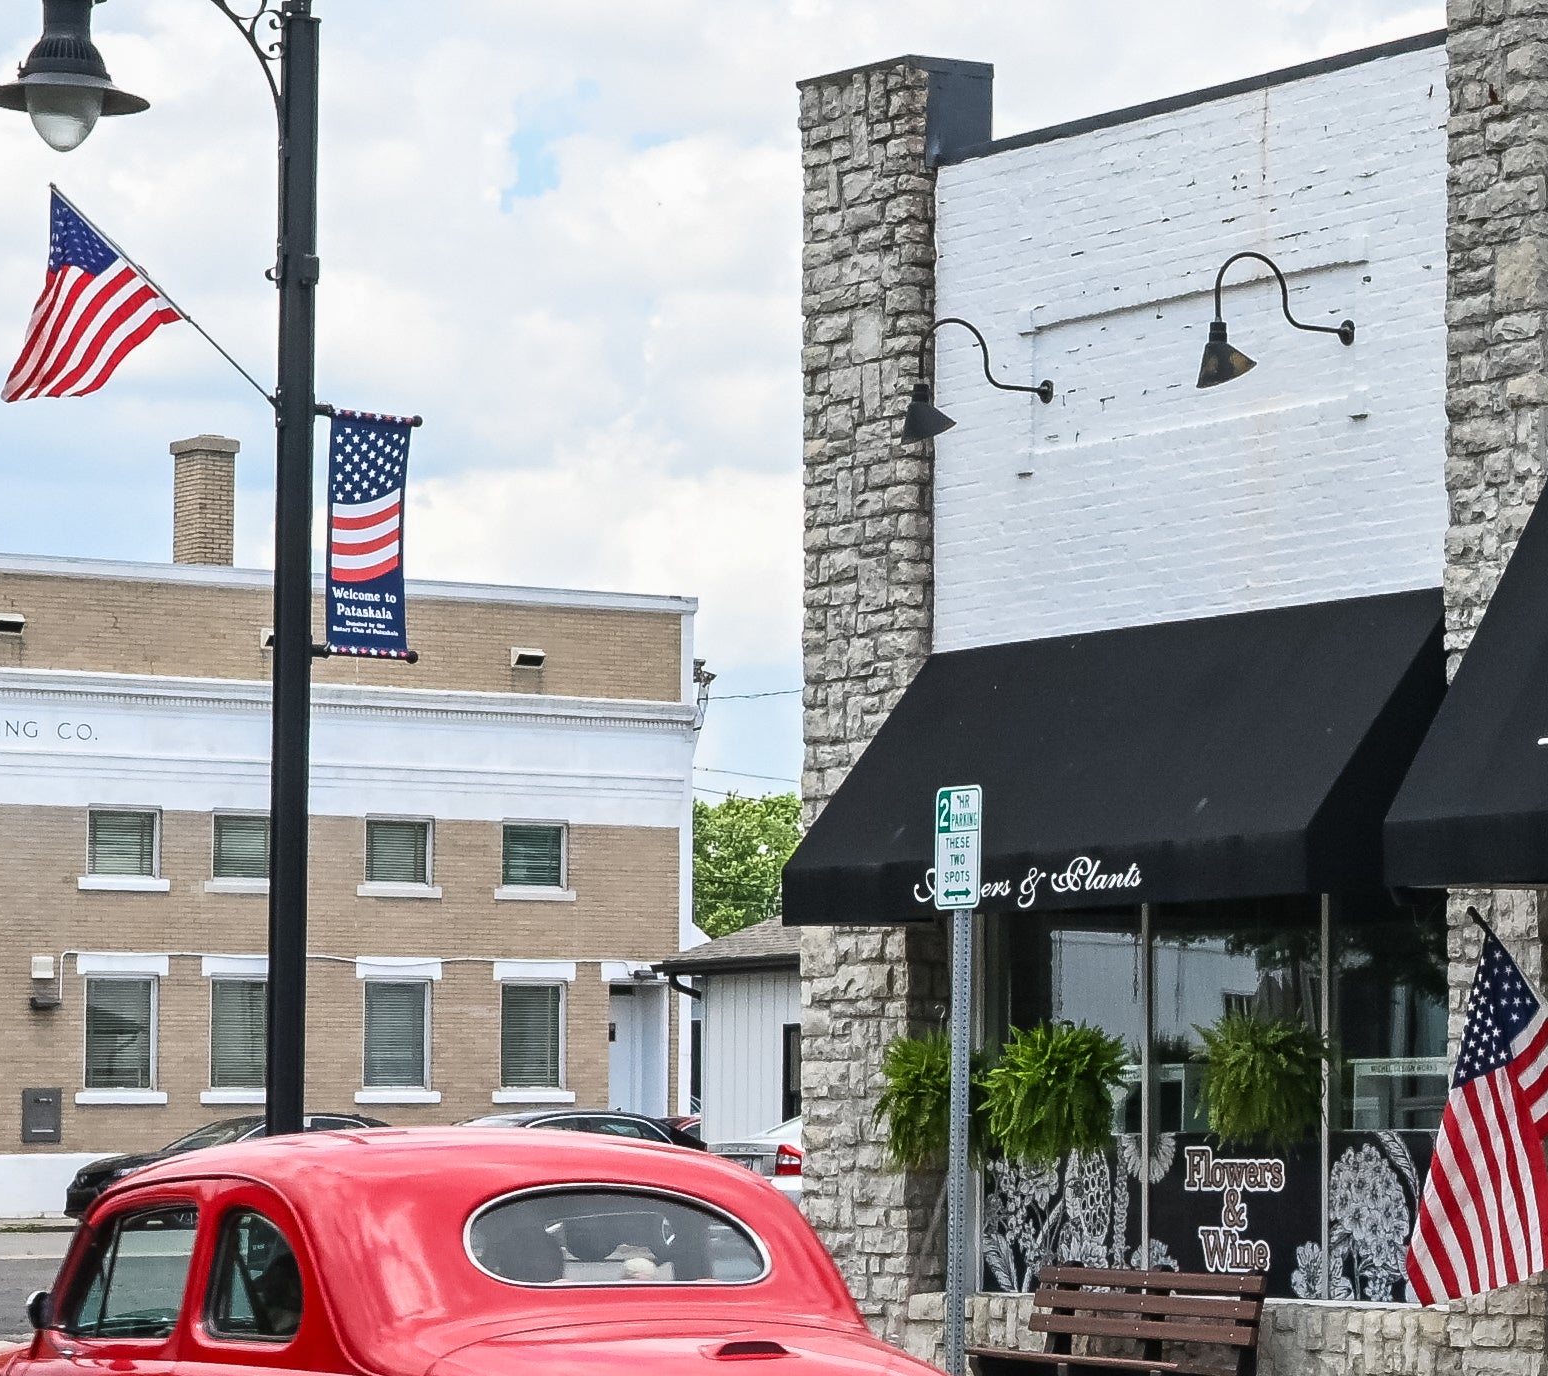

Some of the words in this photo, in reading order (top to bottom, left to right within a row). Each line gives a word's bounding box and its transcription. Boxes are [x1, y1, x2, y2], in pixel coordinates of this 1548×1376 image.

[332, 586, 381, 602] Welcome
[384, 592, 397, 604] to
[336, 602, 394, 620] Pataskala
[57, 722, 99, 741] CO.
[939, 798, 950, 828] 2
[959, 794, 970, 809] HR
[951, 812, 978, 827] PARKING
[945, 836, 971, 849] THESE
[950, 853, 966, 866] TWO
[944, 871, 971, 883] SPOTS
[1017, 867, 1046, 908] &
[1051, 856, 1142, 893] Plants
[1184, 1146, 1286, 1192] Flowers
[1222, 1189, 1248, 1230] &
[1199, 1227, 1270, 1272] Wine
